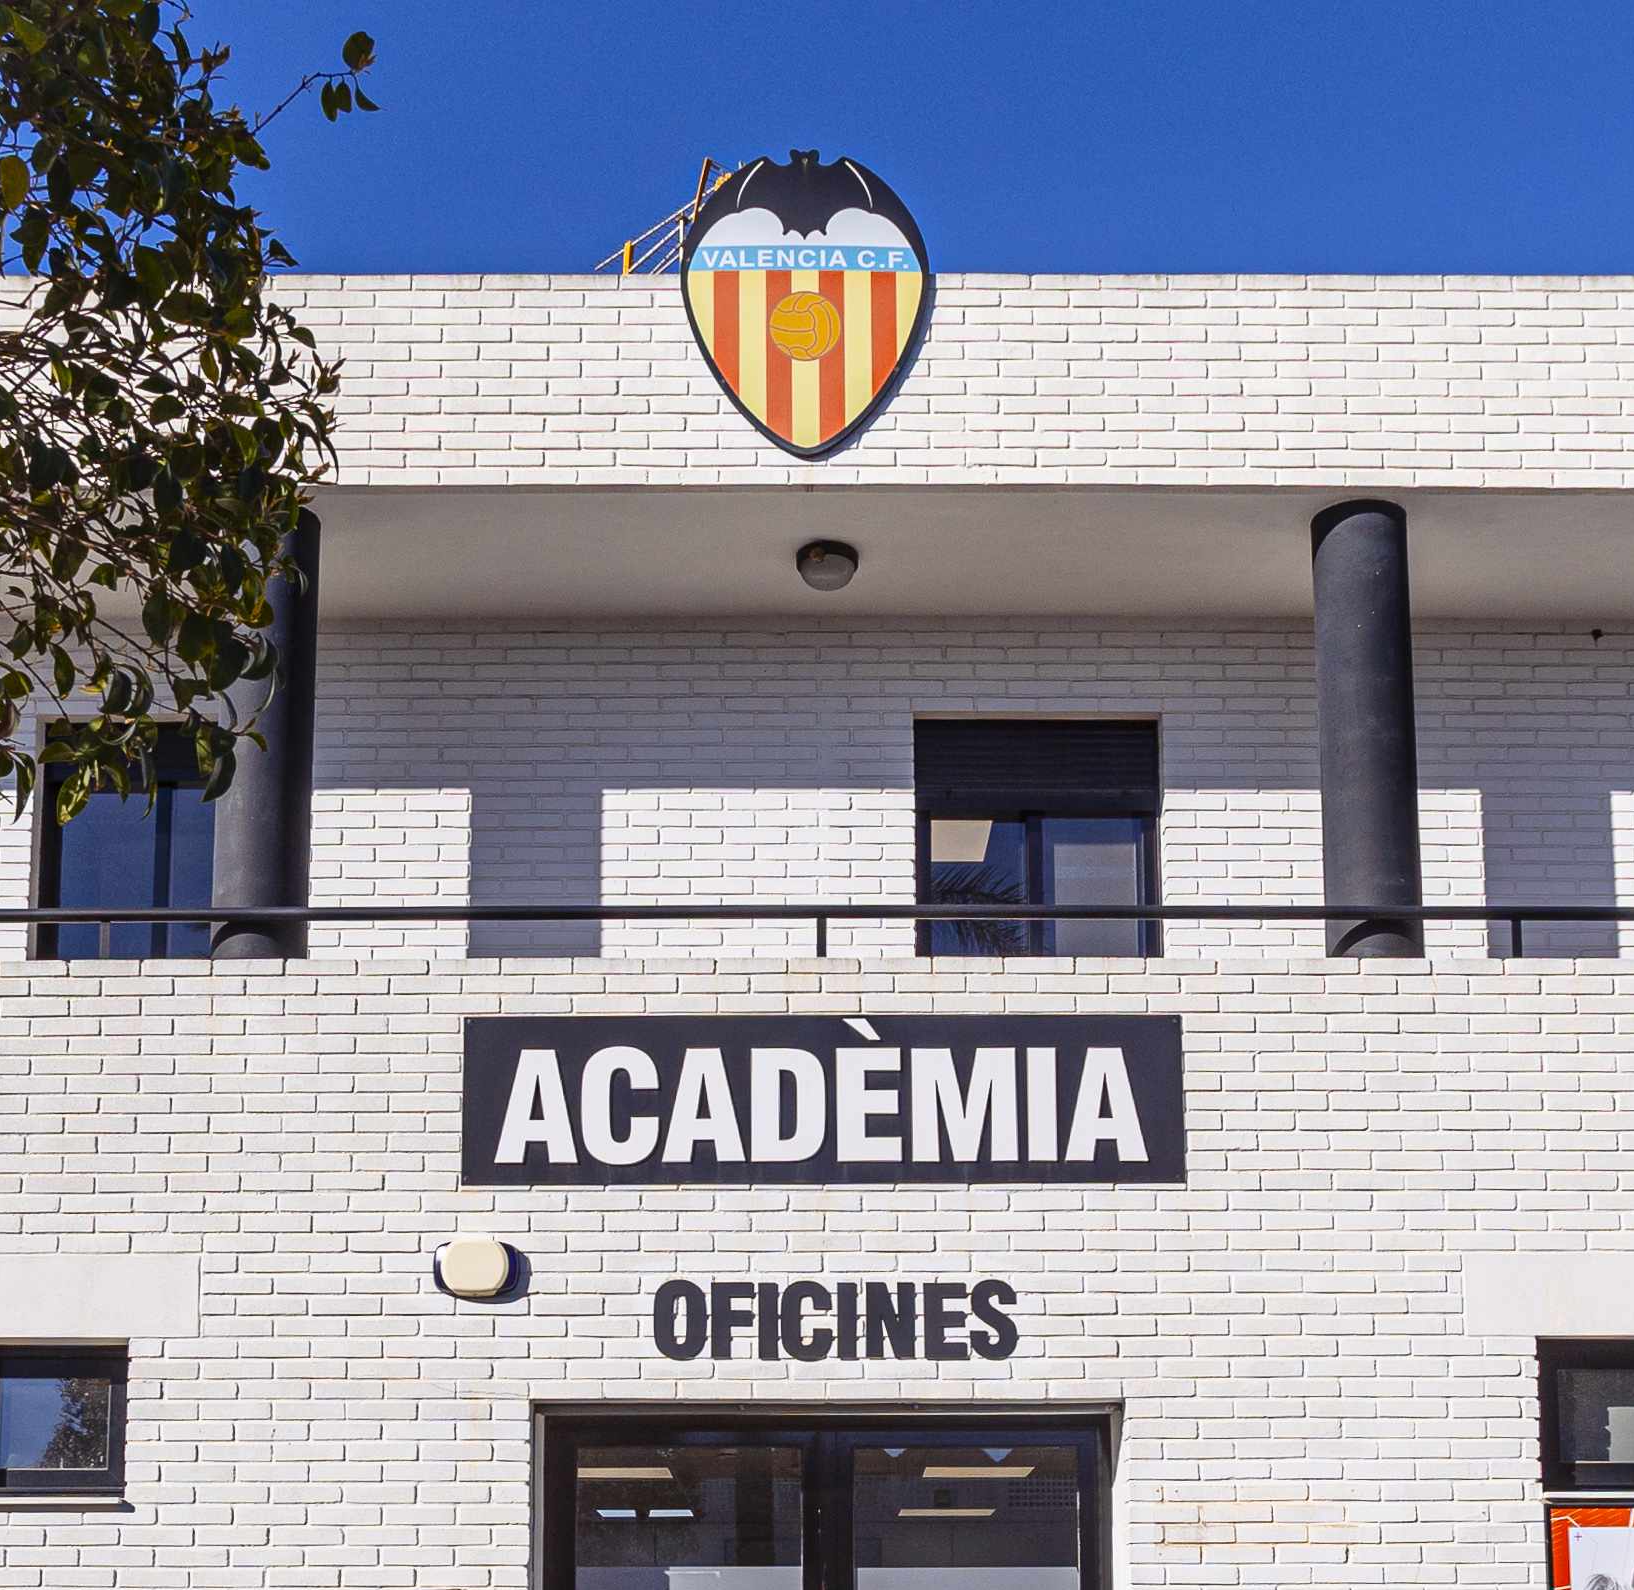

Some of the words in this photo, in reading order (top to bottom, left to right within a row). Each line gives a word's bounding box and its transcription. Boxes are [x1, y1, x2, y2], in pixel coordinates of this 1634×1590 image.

[702, 250, 846, 268] VALENCIA
[857, 250, 909, 269] C.F.
[494, 1018, 1149, 1166] ACADÈMIA
[653, 1279, 1019, 1362] OFICINES
